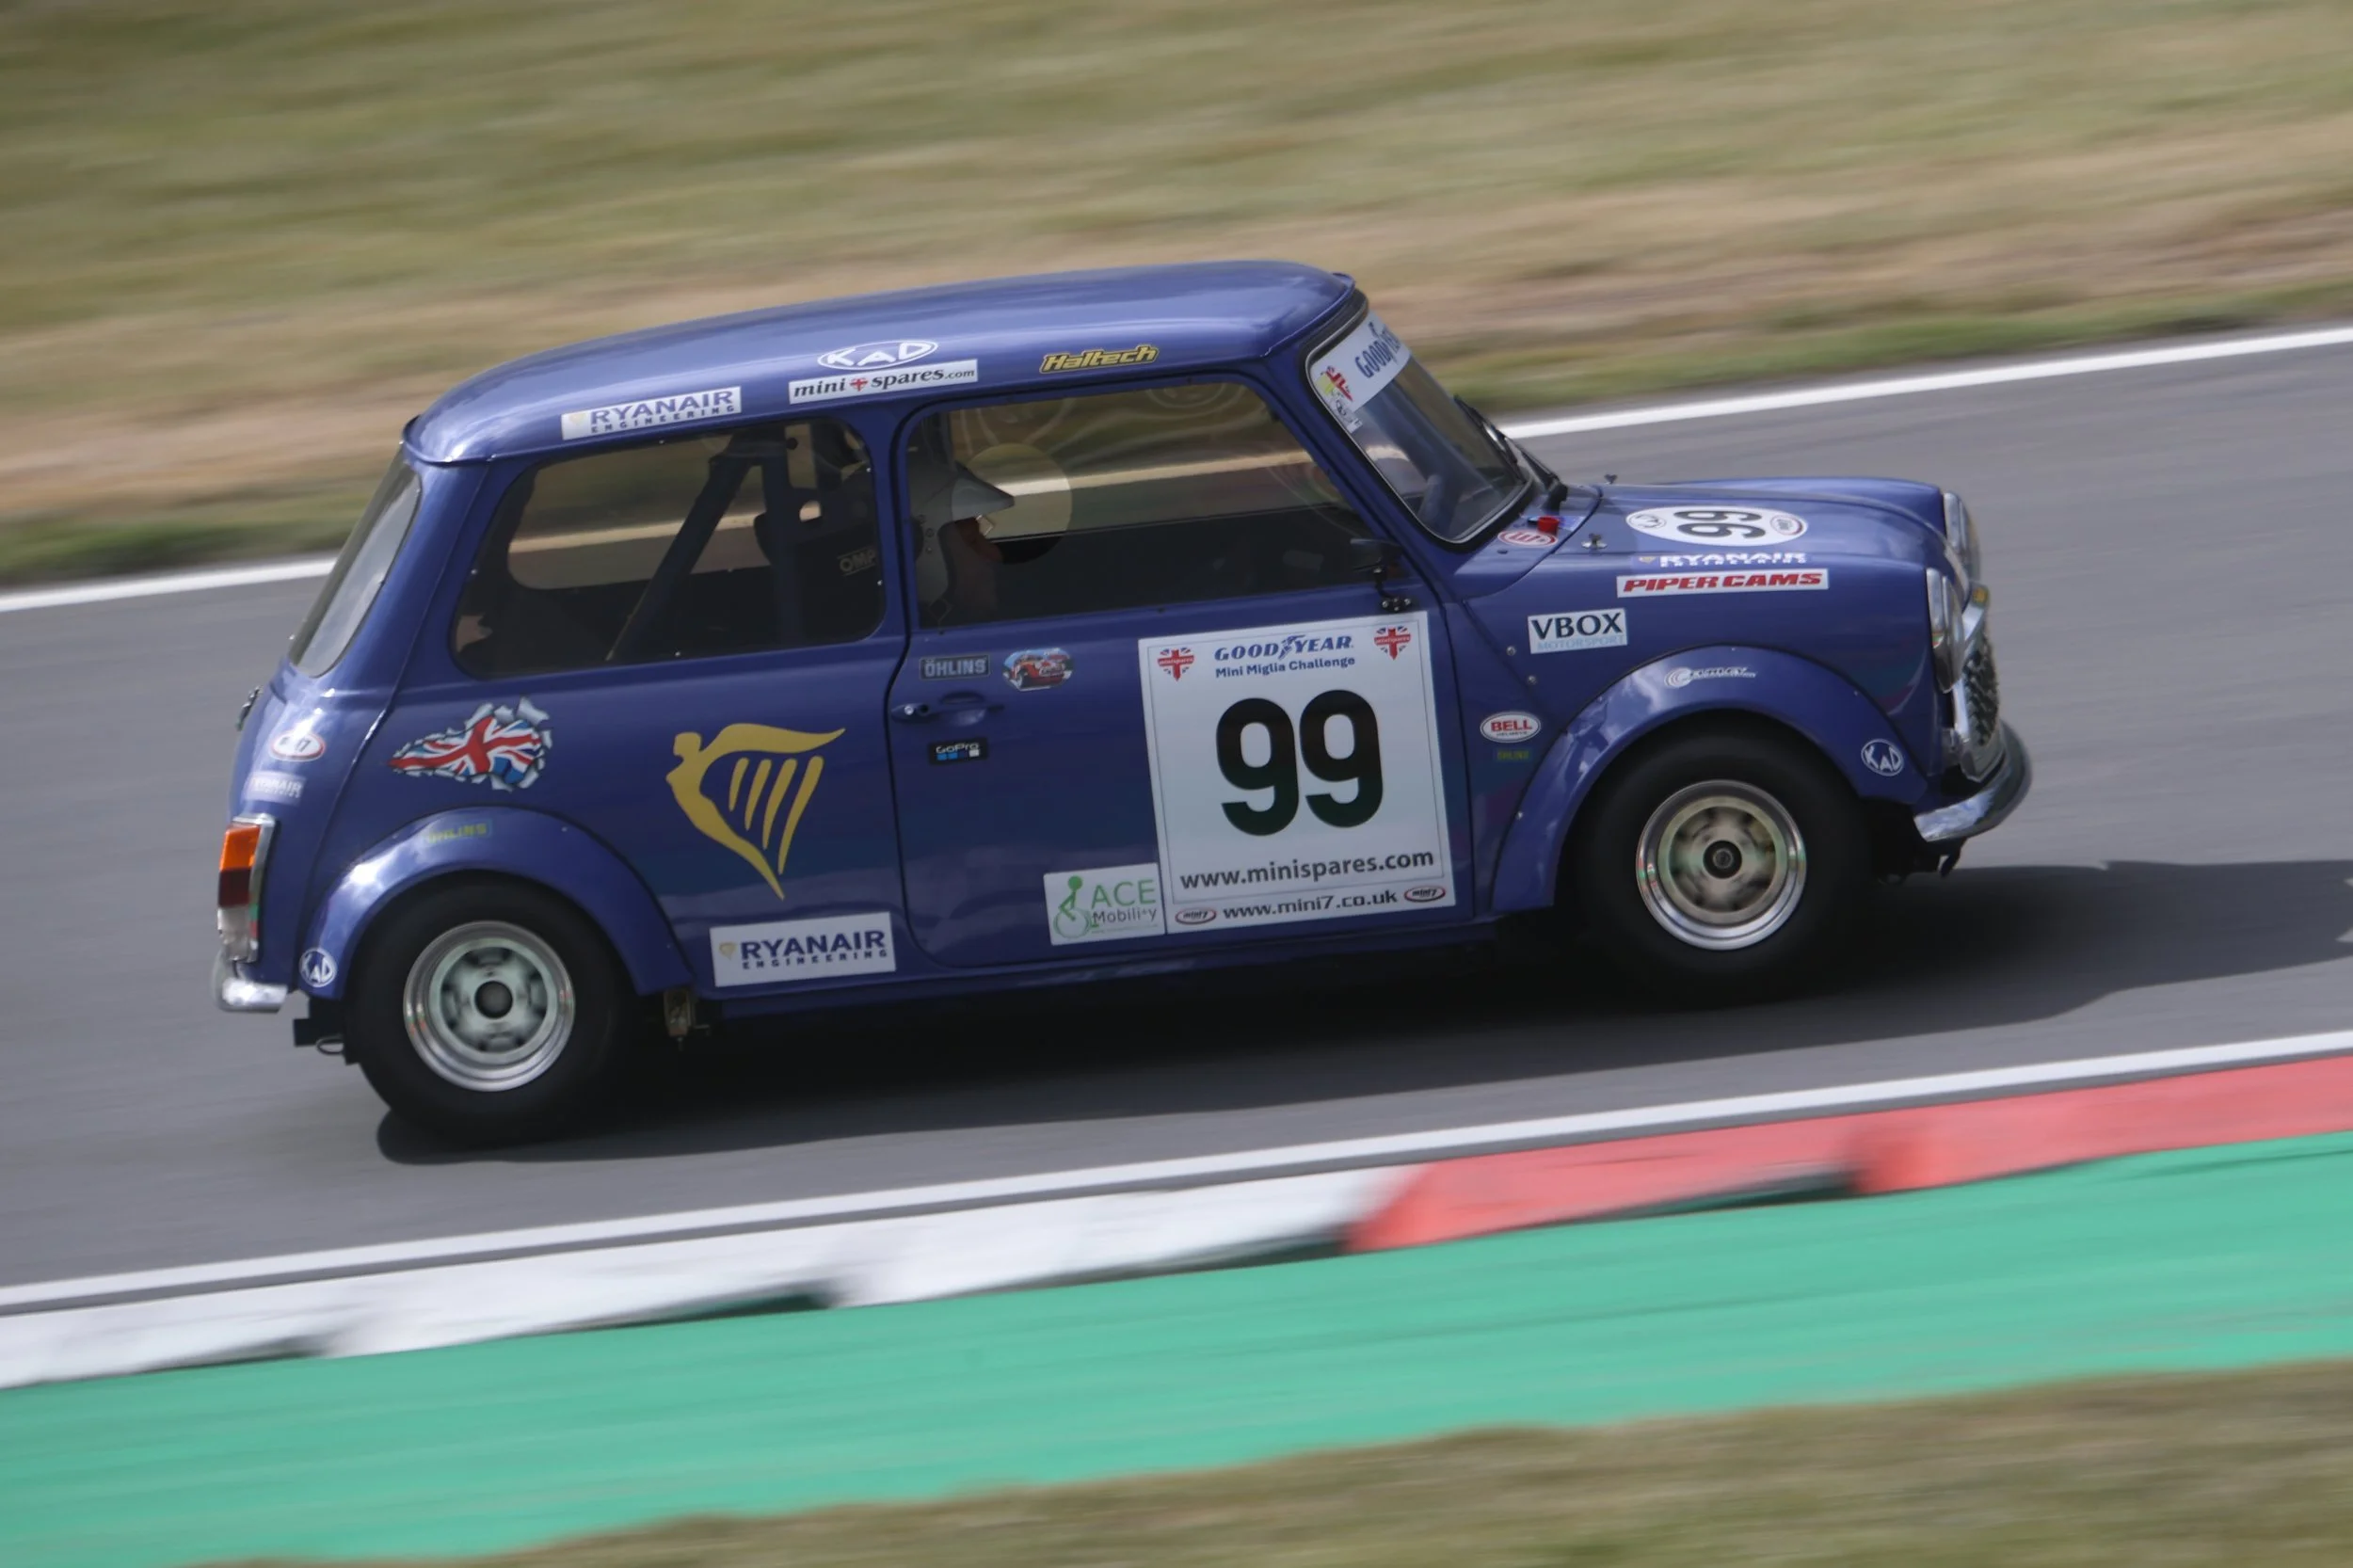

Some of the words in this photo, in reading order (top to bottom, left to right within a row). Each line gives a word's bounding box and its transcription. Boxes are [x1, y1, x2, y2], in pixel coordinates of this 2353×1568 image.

[827, 343, 926, 367] KAD
[1043, 345, 1158, 372] Haltech
[793, 377, 846, 397] mini
[871, 367, 975, 389] spares.com
[590, 391, 732, 424] RYANAIR
[591, 405, 734, 434] ENGINEERING
[1673, 510, 1766, 539] 99
[1623, 576, 1719, 592] PIPER
[1721, 573, 1822, 588] CAMS
[1530, 612, 1624, 641] VBOX
[1214, 634, 1354, 662] GOODYEAR
[1537, 634, 1625, 651] MOTORSPORT
[923, 660, 987, 678] ÖHLINS
[1215, 667, 1243, 679] Mini
[1246, 663, 1286, 676] Miglia
[1289, 656, 1355, 672] Challenge
[1491, 719, 1533, 732] BELL
[936, 743, 980, 754] GoPro
[1865, 744, 1902, 772] KAD
[1216, 689, 1384, 837] 99
[1180, 851, 1433, 889] www.minispares.com
[1091, 879, 1157, 910] ACE
[1224, 889, 1398, 919] www.mini7.co.uk
[1093, 908, 1158, 923] Mobility
[741, 930, 886, 961] RYANAIR
[742, 949, 888, 970] ENGINEERING
